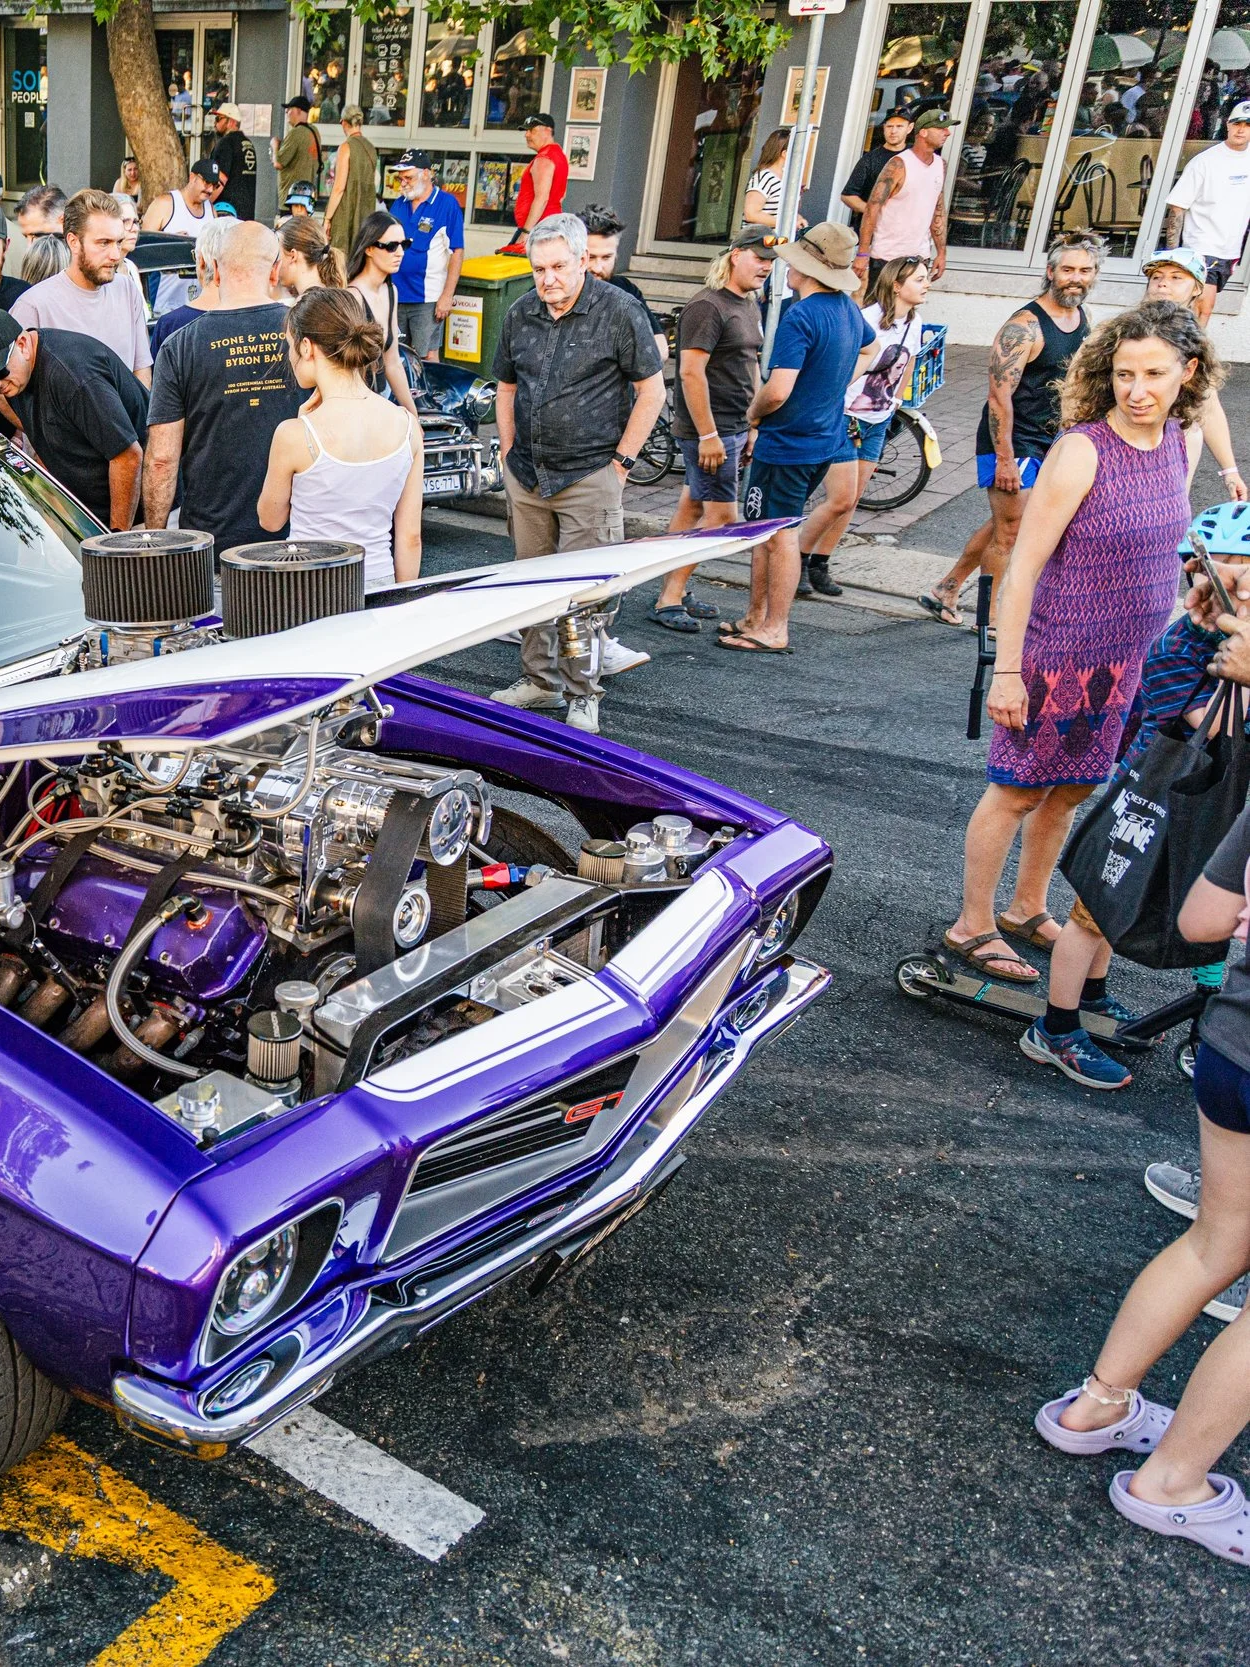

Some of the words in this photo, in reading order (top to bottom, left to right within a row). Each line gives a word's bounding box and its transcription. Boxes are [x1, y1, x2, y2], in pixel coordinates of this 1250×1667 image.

[12, 69, 41, 91] SO
[444, 183, 466, 193] 1975
[210, 335, 245, 350] STONE
[247, 334, 256, 343] &
[259, 332, 286, 341] WOO
[229, 342, 278, 356] BREWERY
[225, 355, 261, 368] BYRON
[264, 353, 283, 363] BAY
[236, 380, 264, 388] CENTENNIAL
[1131, 792, 1149, 807] BEST
